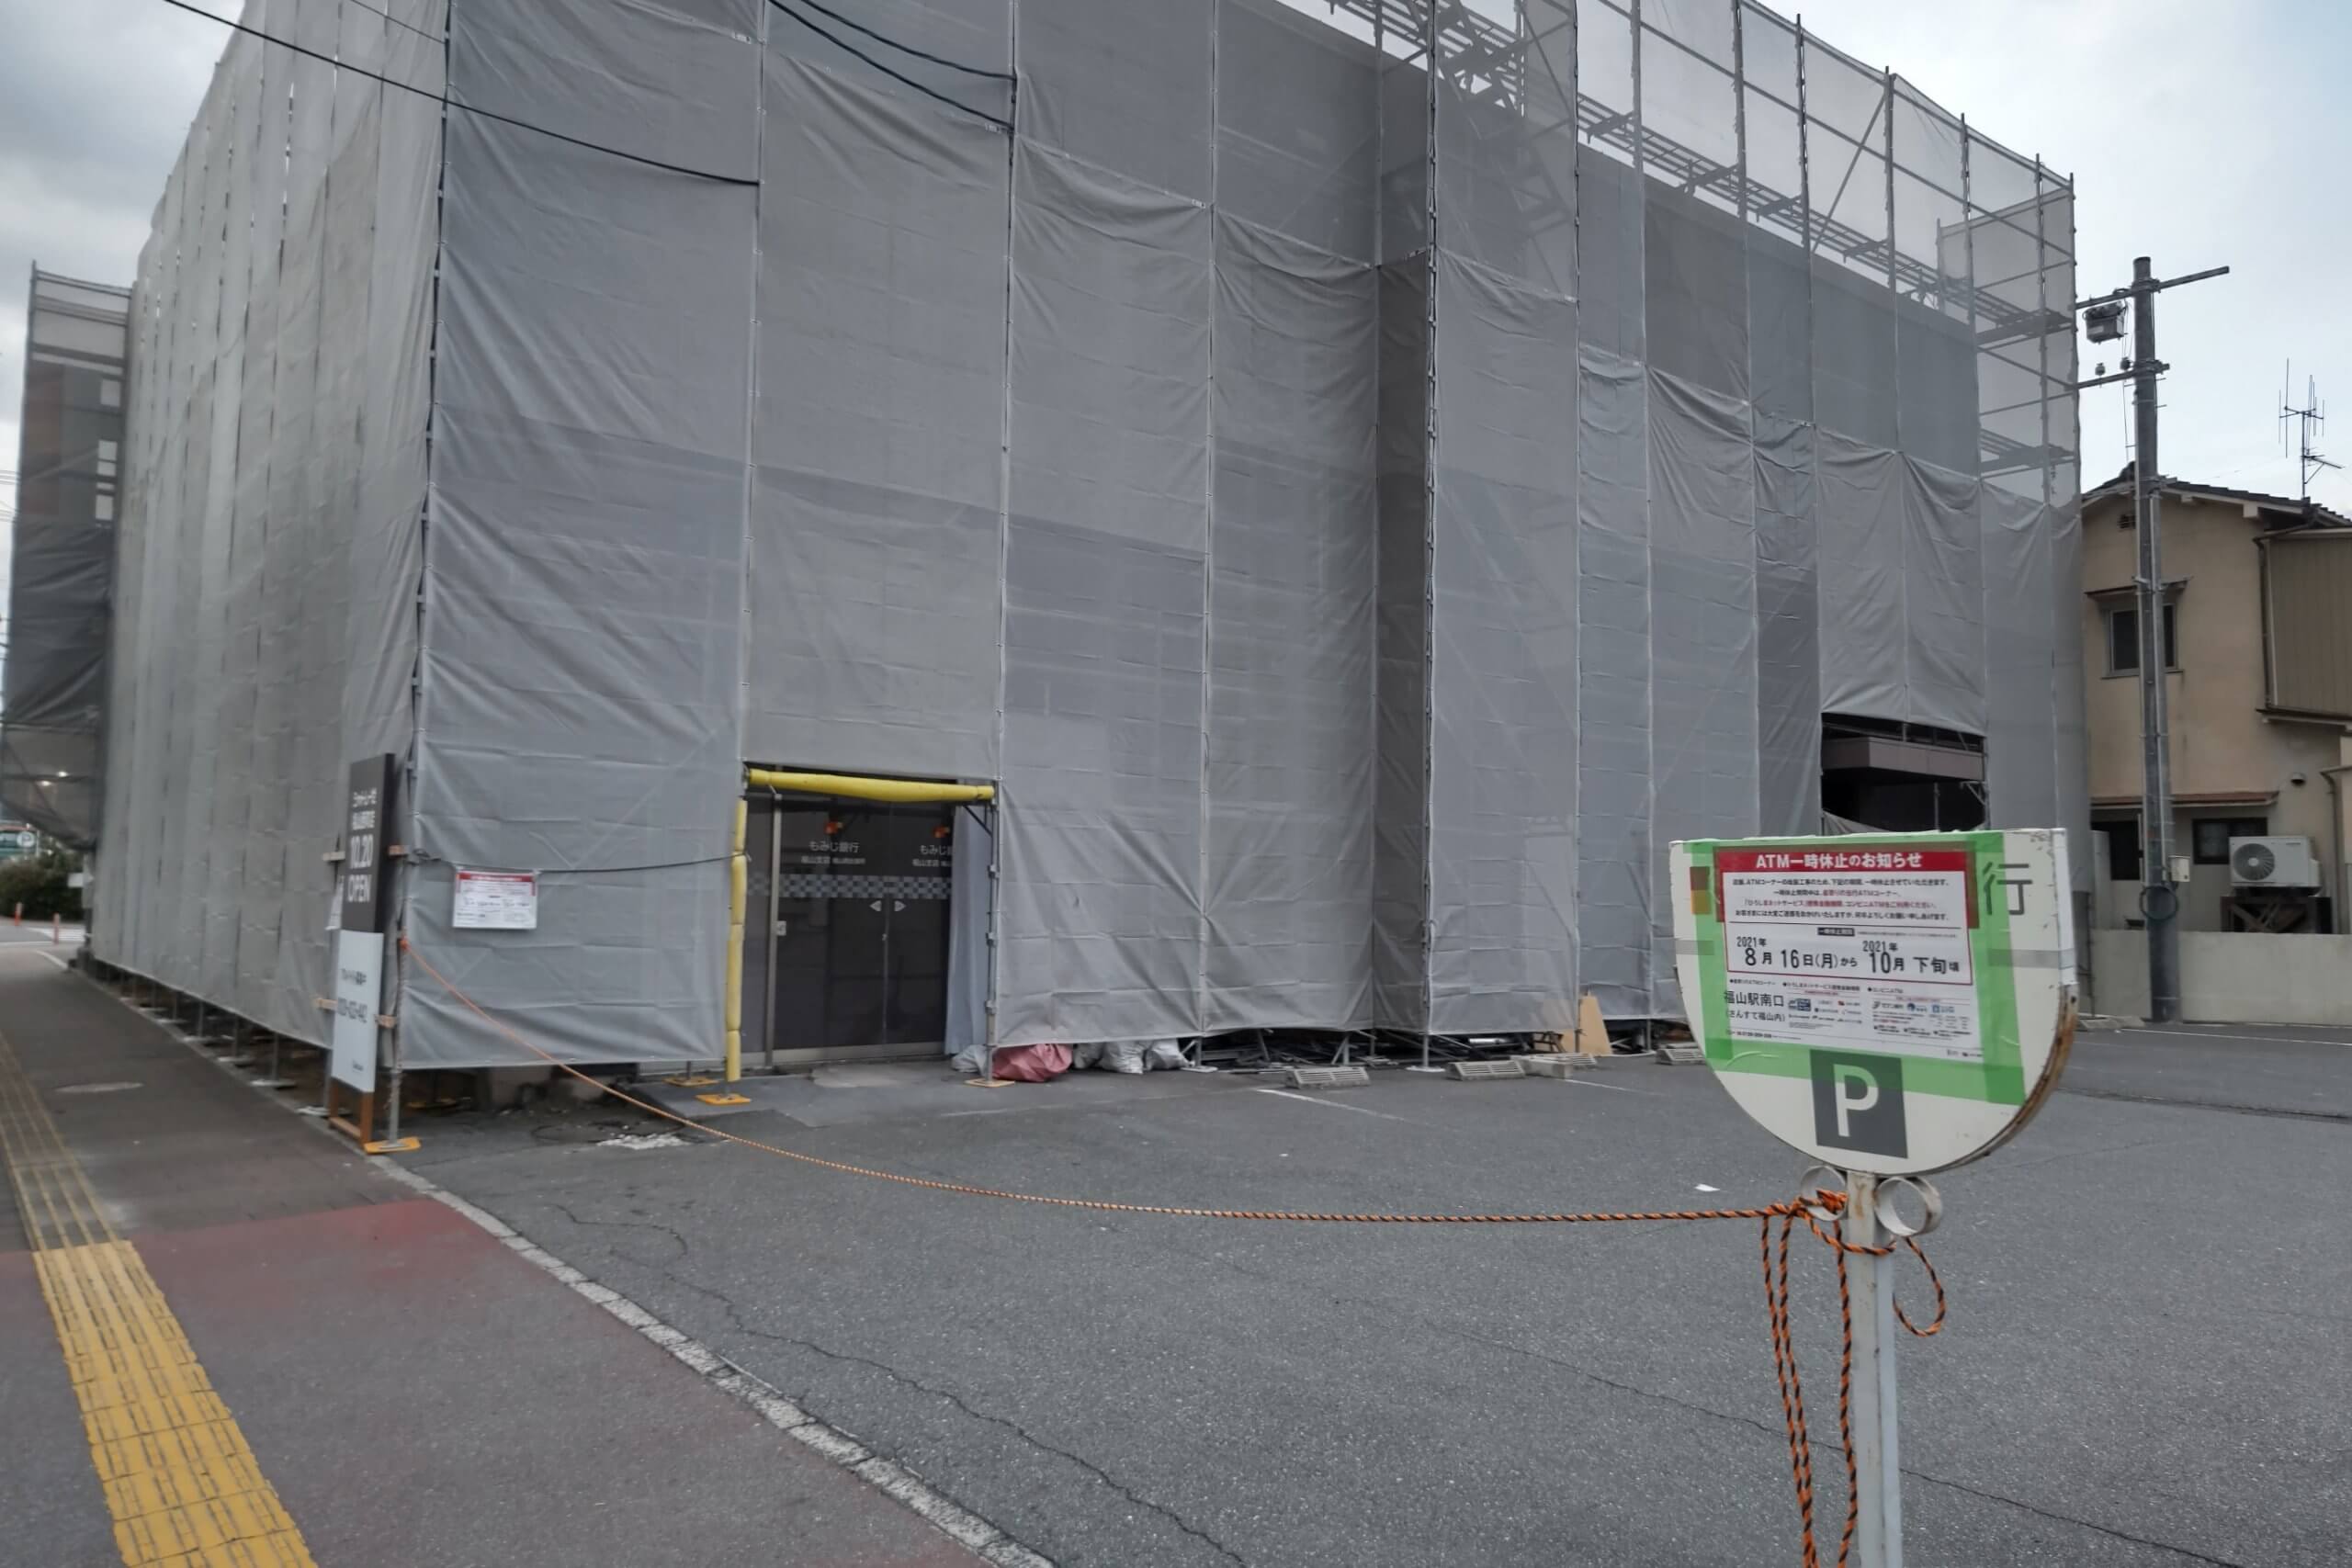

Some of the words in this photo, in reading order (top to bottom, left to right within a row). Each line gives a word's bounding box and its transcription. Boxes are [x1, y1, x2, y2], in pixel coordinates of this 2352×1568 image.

[1755, 852, 1923, 869] ATM一時休止のお知らせ
[1982, 862, 2033, 916] 行
[1736, 936, 1767, 947] 2021年
[1862, 940, 1898, 953] 2021年
[1913, 956, 1960, 975] 下旬頃
[1724, 990, 1784, 1007] 福山駅南口
[1833, 1064, 1879, 1138] P
